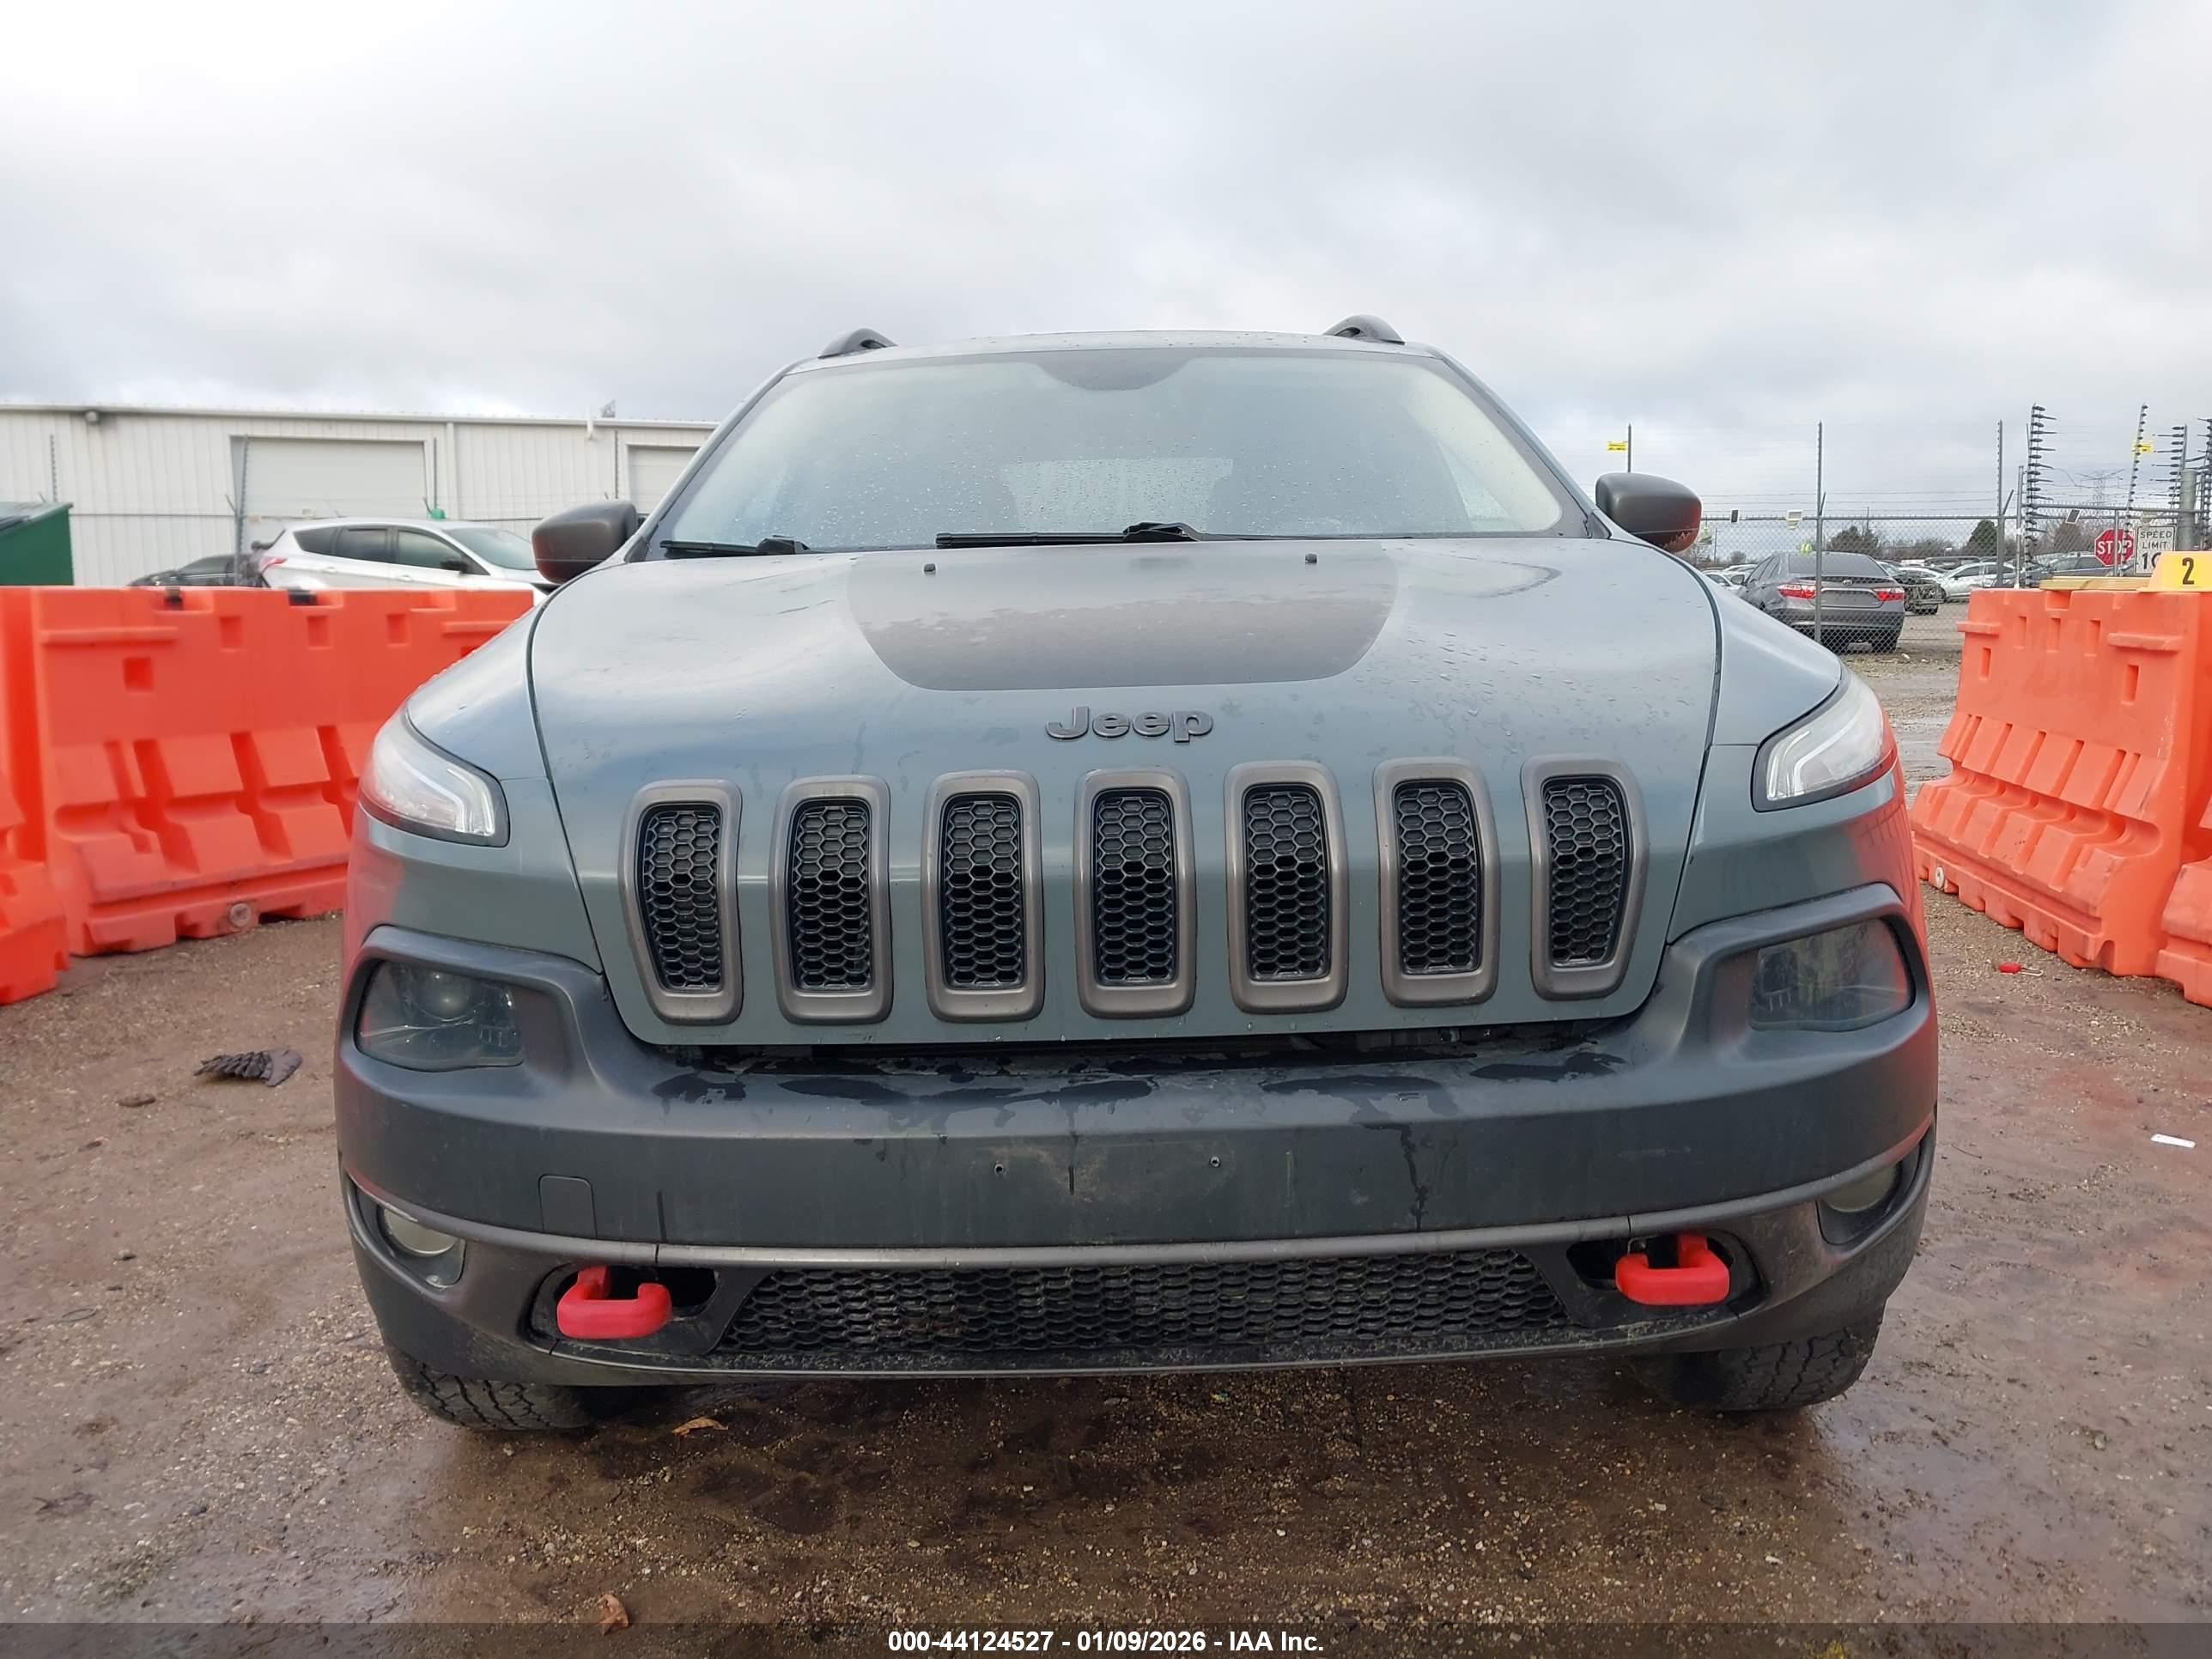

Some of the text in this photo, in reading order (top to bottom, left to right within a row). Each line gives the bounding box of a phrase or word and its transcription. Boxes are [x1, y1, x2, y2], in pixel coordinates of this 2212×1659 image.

[2142, 541, 2168, 550] LIMIT
[2182, 556, 2195, 585] 2
[1045, 706, 1213, 744] Jeep
